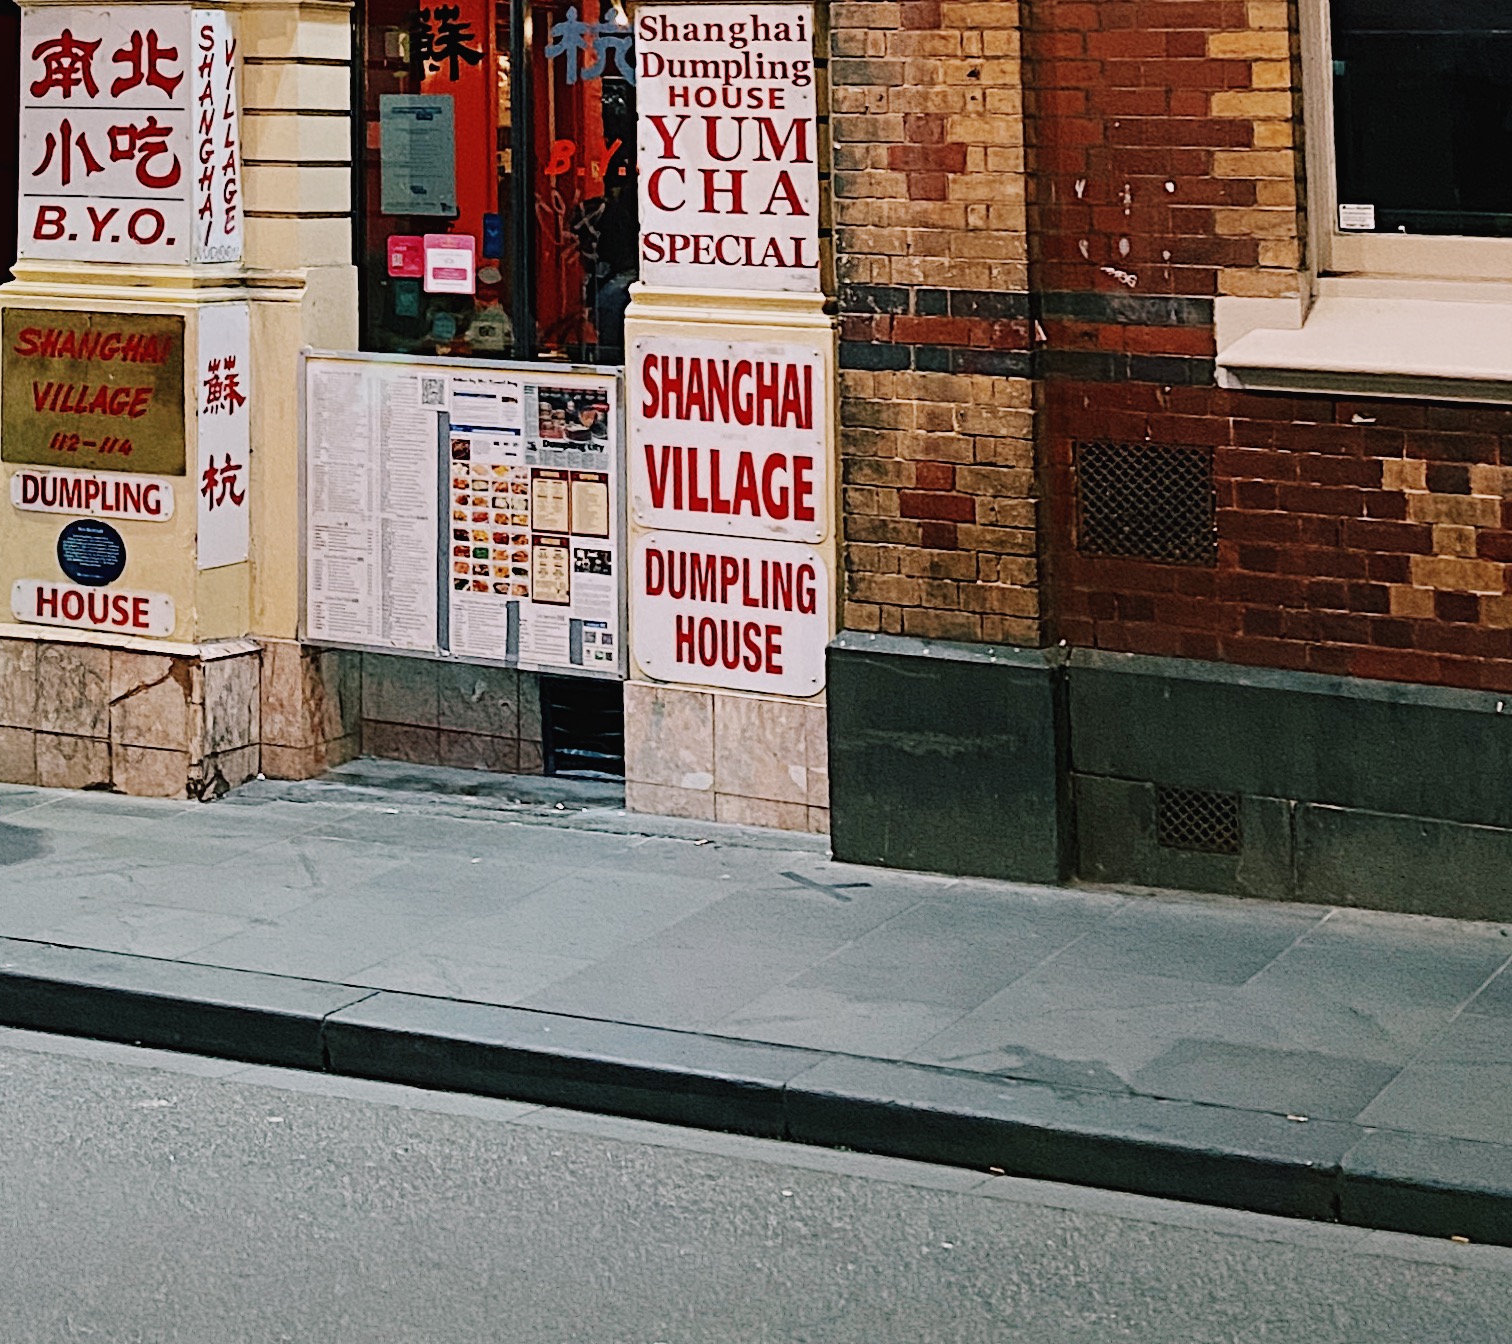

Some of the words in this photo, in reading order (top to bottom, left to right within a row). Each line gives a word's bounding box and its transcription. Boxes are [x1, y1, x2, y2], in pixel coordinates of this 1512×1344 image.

[639, 14, 808, 49] Shanghai
[30, 28, 184, 99] 南北
[641, 51, 811, 87] Dumpling
[669, 85, 785, 109] HOUSE
[32, 116, 182, 188] 小吃
[198, 25, 215, 246] SHANGHAI
[222, 38, 237, 234] VILLAGE
[645, 115, 813, 163] YUM
[544, 138, 638, 177] B.Y.
[647, 166, 810, 216] CHA
[33, 205, 175, 246] B.Y.O.
[642, 231, 819, 269] SPECIAL
[14, 327, 175, 364] SHANGHAI
[32, 380, 153, 418] VILLAGE
[642, 353, 813, 430] SHANGHAI
[49, 432, 133, 456] 112-114
[22, 474, 161, 515] DUMPLING
[645, 444, 815, 522] VILLAGE
[645, 548, 816, 614] DUMPLING
[36, 586, 150, 628] HOUSE
[676, 614, 783, 675] HOUSE
